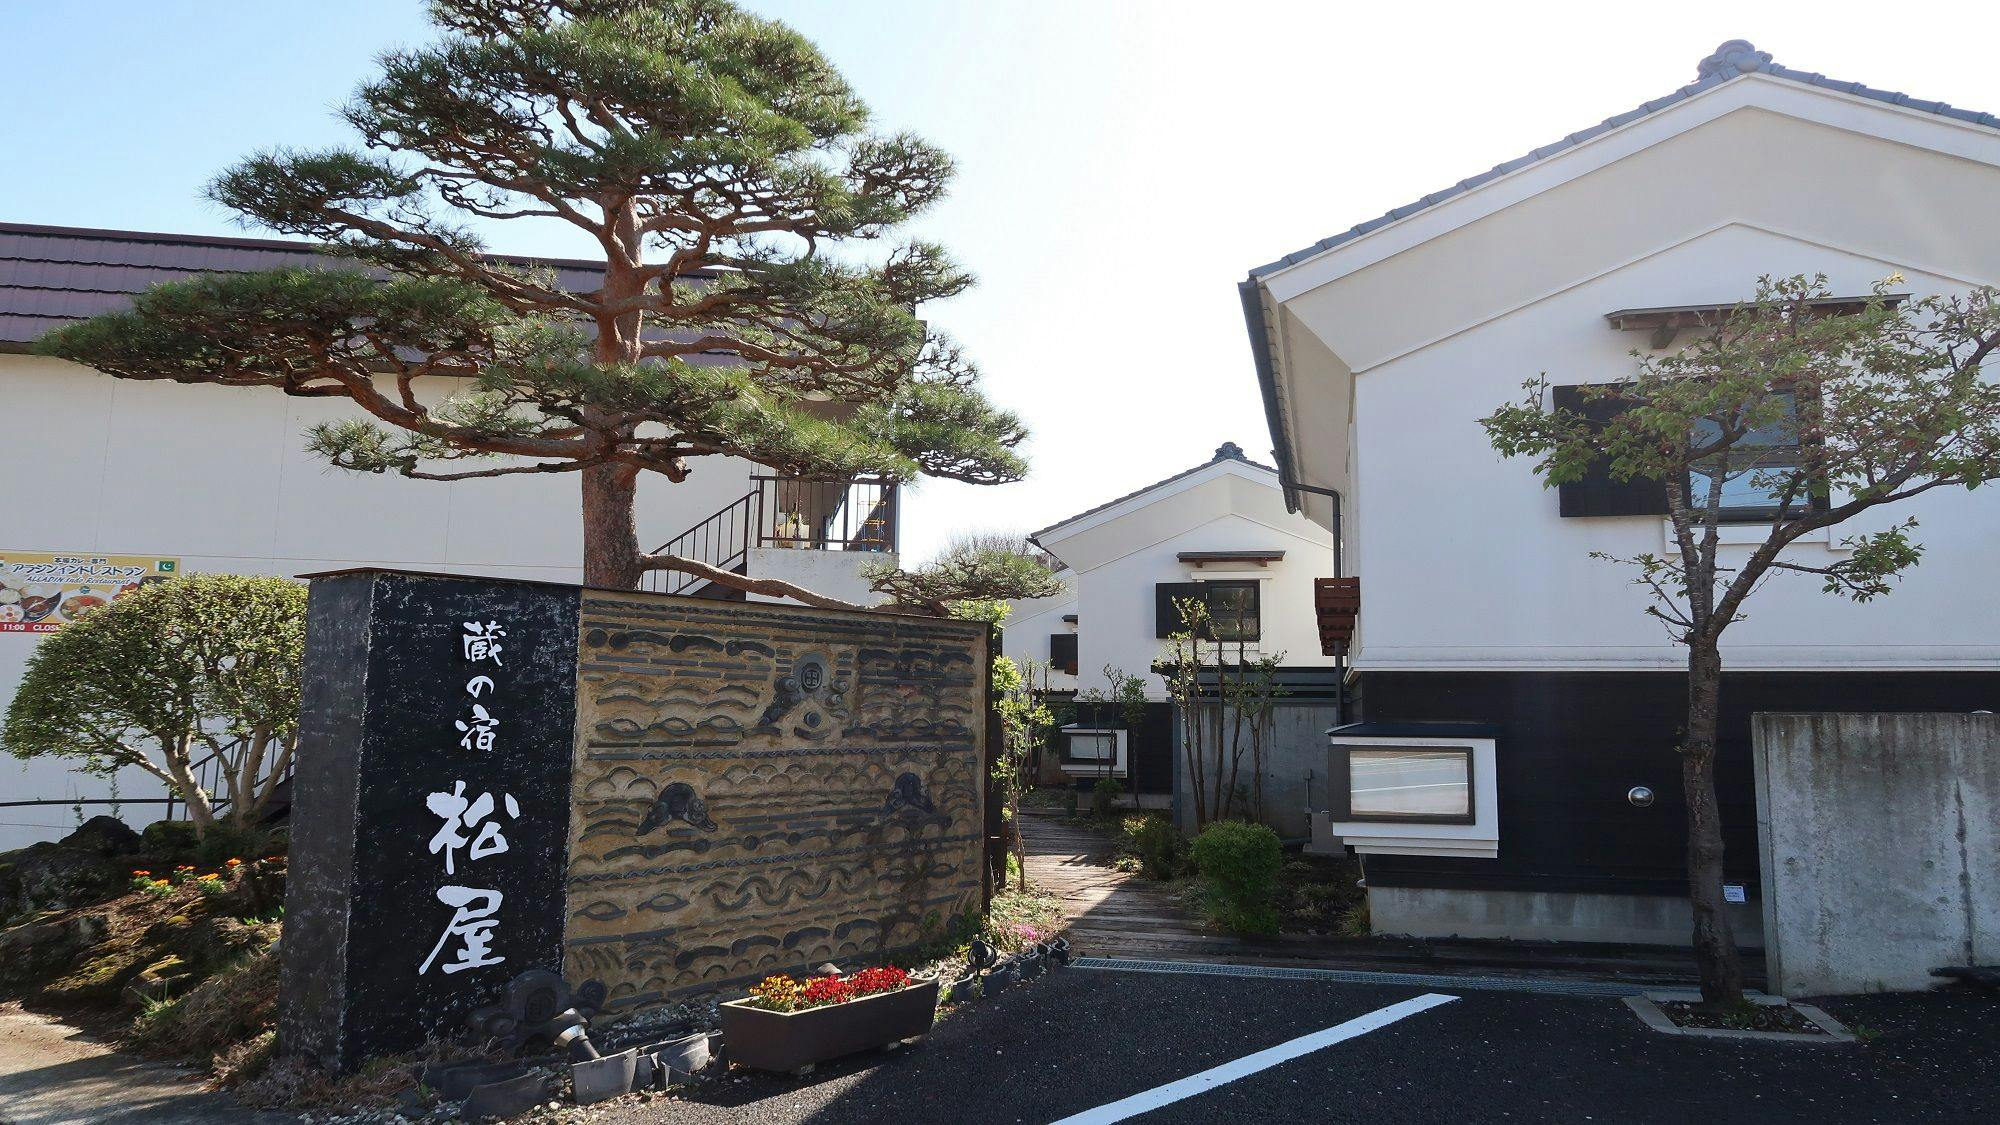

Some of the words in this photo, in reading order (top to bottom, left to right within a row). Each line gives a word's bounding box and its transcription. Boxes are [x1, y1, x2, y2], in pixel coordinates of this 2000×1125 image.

[13, 564, 146, 576] アラジンインドレストラン
[85, 577, 131, 585] Restaurant
[3, 623, 25, 631] 11:00
[455, 620, 506, 752] 蔵の宿
[418, 781, 521, 976] 松屋
